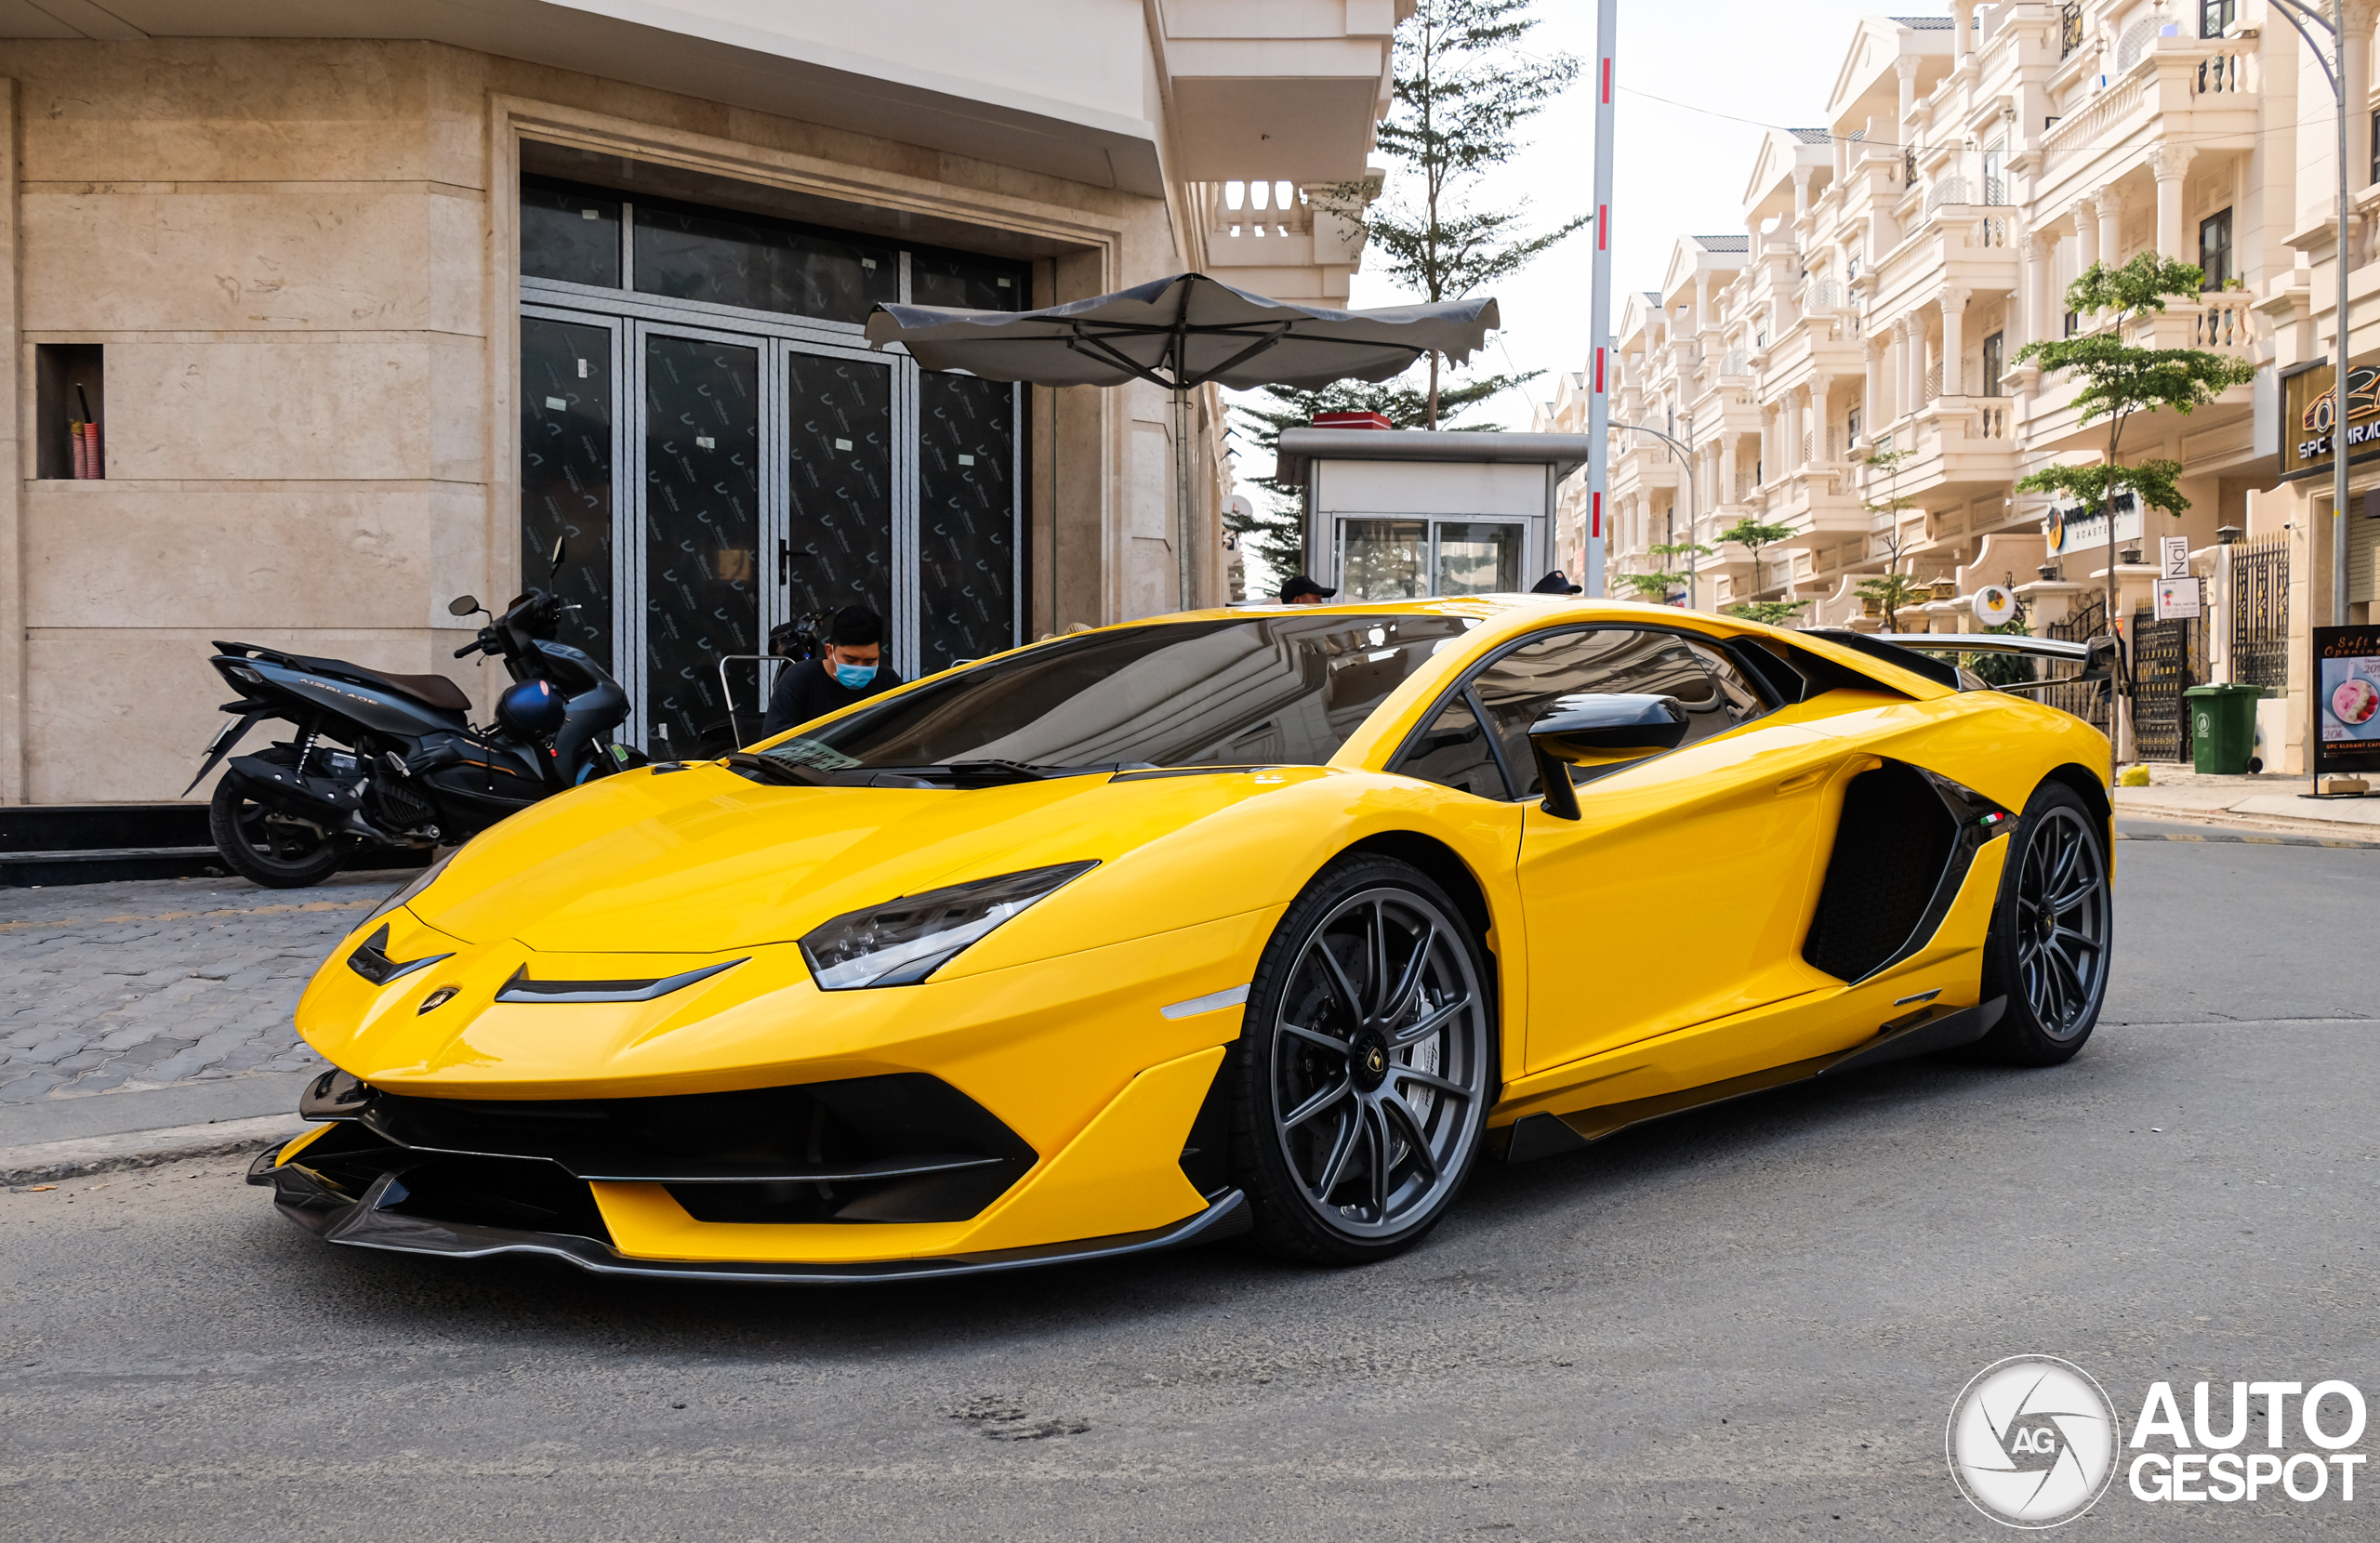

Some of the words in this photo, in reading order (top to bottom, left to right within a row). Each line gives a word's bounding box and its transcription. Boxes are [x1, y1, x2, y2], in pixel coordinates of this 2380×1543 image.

[665, 357, 680, 384] Window
[732, 371, 747, 398] Window
[852, 379, 866, 406] Window
[715, 399, 730, 426] Window
[837, 407, 851, 433] Window
[948, 420, 962, 445] Window
[581, 435, 598, 463] Window
[821, 434, 836, 460] Window
[934, 446, 948, 471] Window
[2298, 437, 2326, 459] SPC
[562, 466, 579, 494] Window
[681, 455, 697, 482] Window
[805, 462, 820, 488] Window
[664, 484, 680, 512] Window
[866, 472, 880, 498] Window
[544, 495, 561, 523] Window
[732, 495, 747, 522] Window
[852, 500, 866, 526] Window
[525, 526, 542, 555] Window
[837, 528, 851, 553] Window
[2076, 521, 2120, 540] ROASTEY
[698, 554, 714, 581] Window
[822, 556, 836, 581] Window
[2168, 541, 2186, 575] Nail
[581, 567, 598, 595] Window
[681, 583, 697, 610] Window
[806, 584, 820, 610] Window
[665, 613, 680, 640] Window
[732, 621, 747, 647] Window
[2337, 636, 2369, 649] Soft
[698, 679, 714, 706] Window
[681, 710, 697, 736] Window
